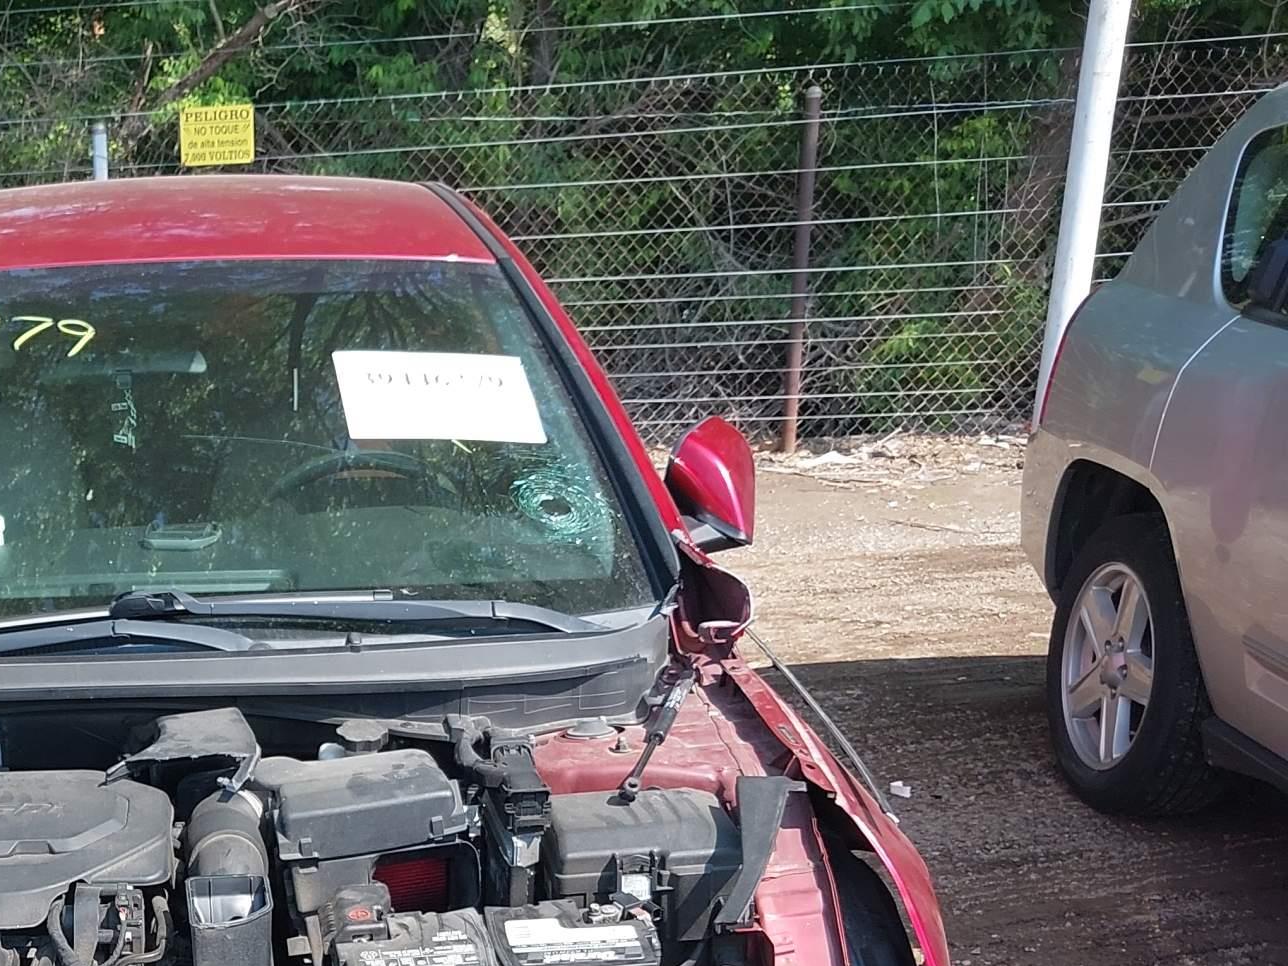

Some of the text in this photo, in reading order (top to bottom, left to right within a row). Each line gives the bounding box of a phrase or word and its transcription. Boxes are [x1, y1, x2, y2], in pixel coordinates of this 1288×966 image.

[185, 109, 250, 123] PELIGRO
[194, 124, 240, 137] NO TOQUE
[208, 149, 251, 161] VOLTIOS
